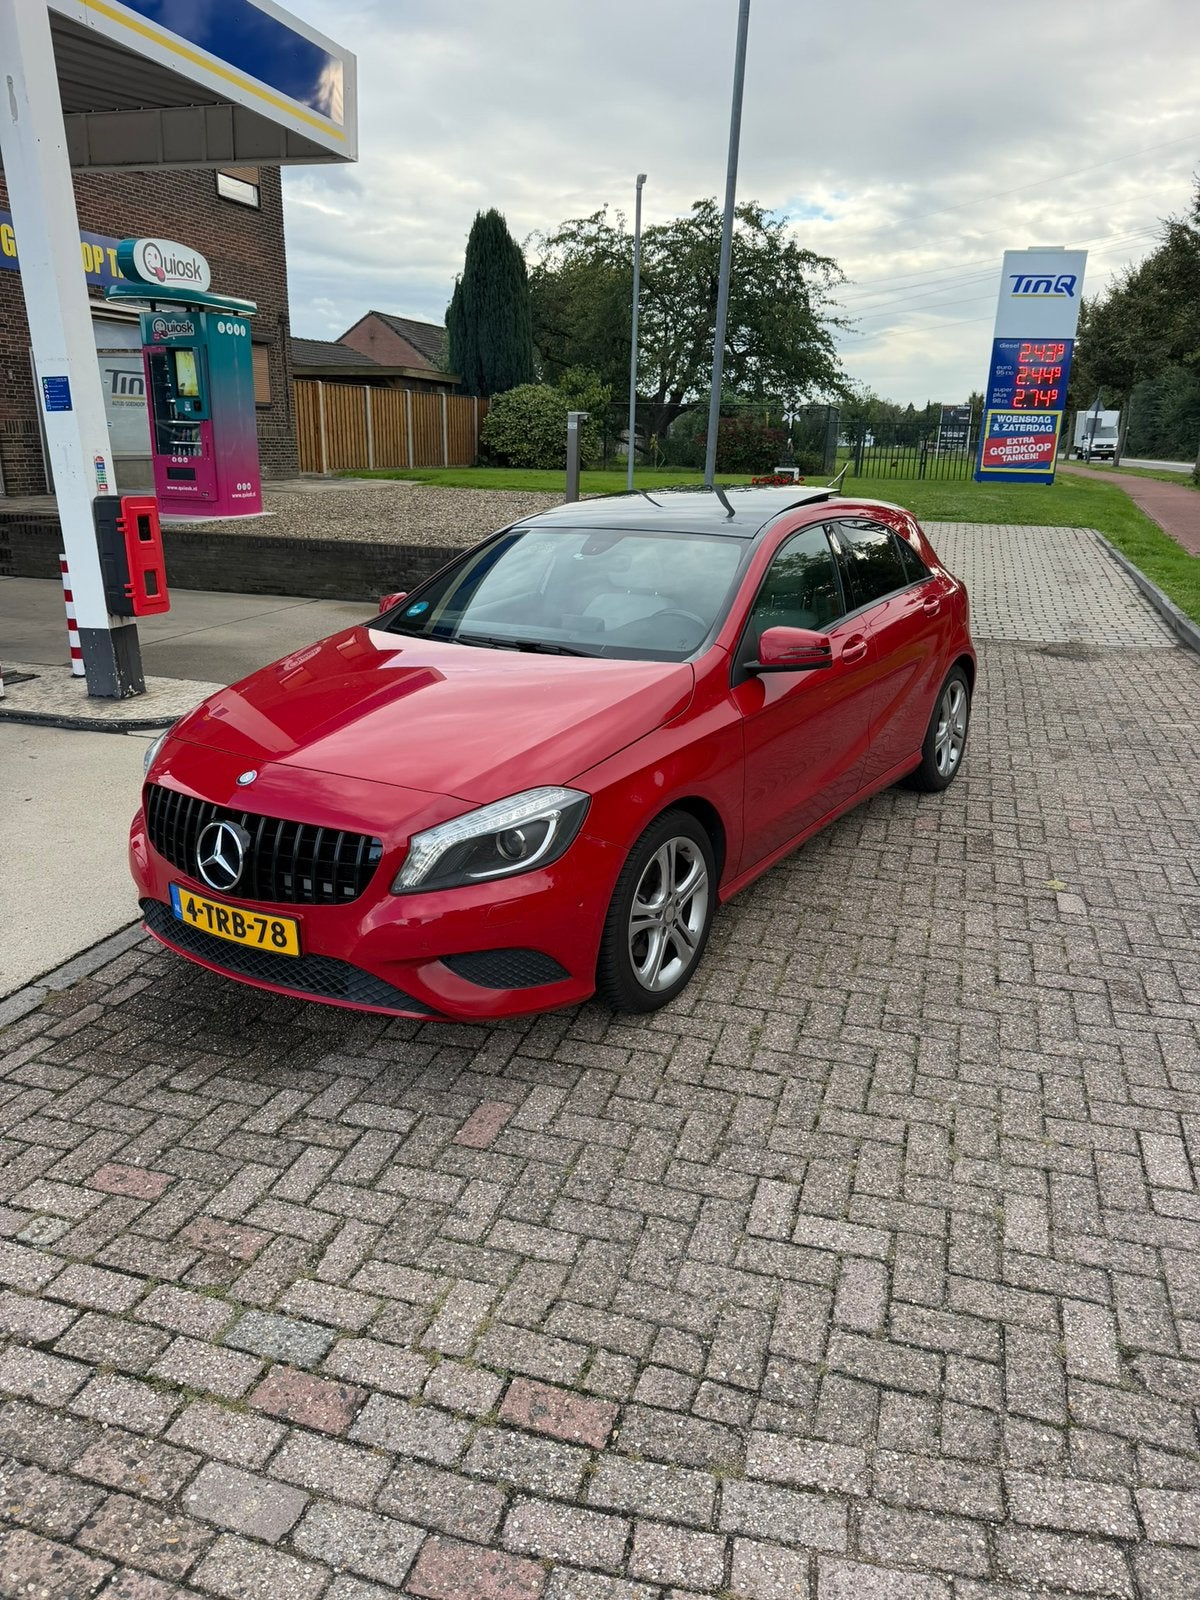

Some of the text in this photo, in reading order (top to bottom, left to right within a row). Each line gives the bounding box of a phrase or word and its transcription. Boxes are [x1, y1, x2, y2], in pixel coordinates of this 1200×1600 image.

[143, 242, 202, 282] Quiosk
[1009, 274, 1077, 298] TinQ
[153, 318, 194, 337] Quiosk
[105, 369, 145, 394] Tin
[997, 415, 1052, 423] WOENSDAG
[1002, 424, 1053, 432] ZATERDAG
[990, 443, 1052, 455] GOEDKOOP
[1002, 453, 1039, 462] TANKEN!
[186, 897, 288, 948] 4-TRB-78
